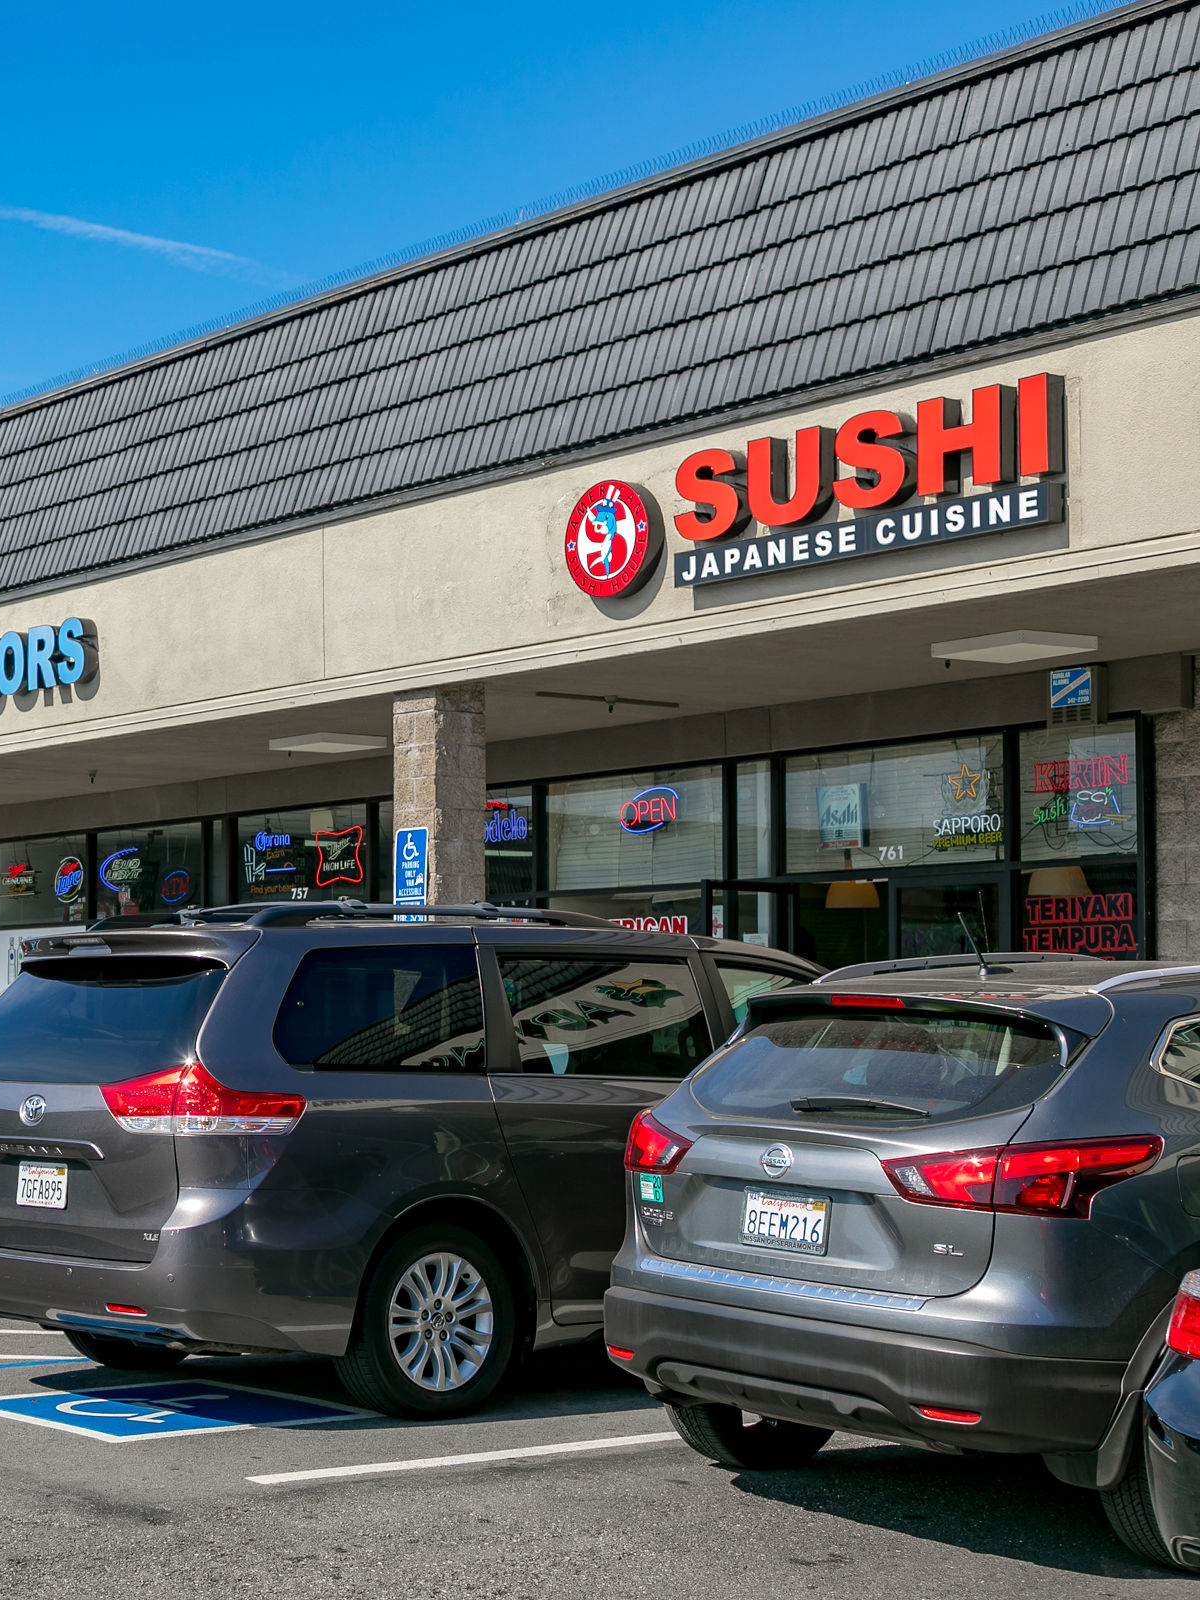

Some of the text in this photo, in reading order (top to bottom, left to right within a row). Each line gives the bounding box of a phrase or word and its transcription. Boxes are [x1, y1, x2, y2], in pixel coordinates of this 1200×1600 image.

[674, 372, 1049, 541] SUSHI
[570, 484, 643, 532] AMERCAN
[681, 489, 1039, 581] JAPANESE CUISINE
[568, 535, 646, 594] SUSHI HOUSE
[1033, 753, 1128, 793] KIRIN
[620, 797, 676, 827] OPEN
[821, 802, 858, 827] Asahi
[932, 813, 1000, 837] SAPPORO
[255, 832, 290, 851] Corona
[931, 831, 1003, 848] PREMIUM BEER
[878, 845, 903, 860] 761
[323, 860, 355, 872] HIGH LIFE
[2, 876, 33, 885] GENUINE
[161, 876, 190, 897] ATM
[291, 887, 308, 899] 757
[1025, 893, 1133, 925] TERIYAKI
[1023, 923, 1137, 952] TEMPURA
[21, 1178, 63, 1201] 7GFA895
[652, 1175, 662, 1189] 20
[655, 1190, 661, 1201] D
[761, 1197, 813, 1211] California
[143, 1232, 160, 1241] XLE
[747, 1209, 822, 1243] 8EEM216
[743, 1234, 765, 1244] NISSAN
[776, 1239, 820, 1252] SERRAMONTE
[933, 1243, 964, 1257] SL
